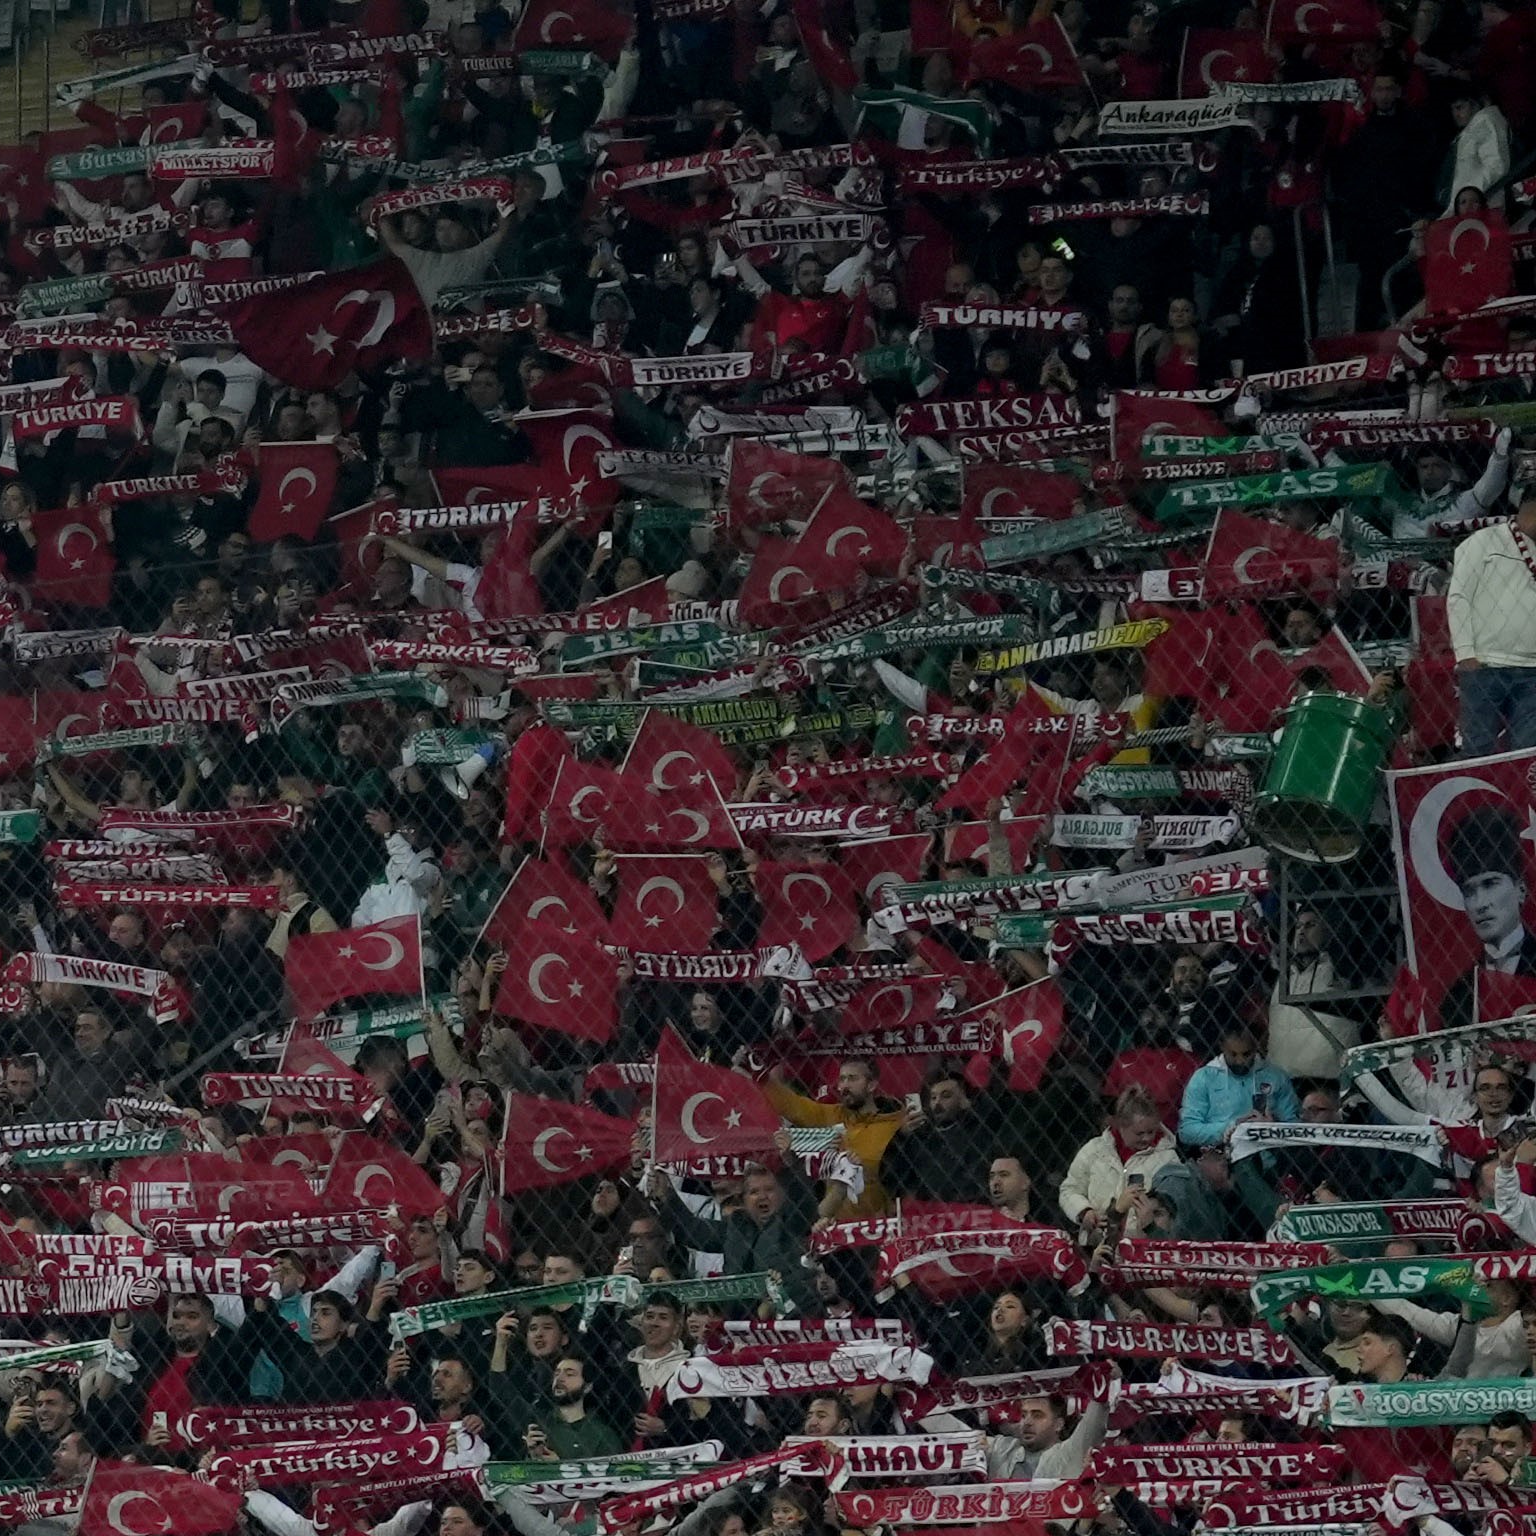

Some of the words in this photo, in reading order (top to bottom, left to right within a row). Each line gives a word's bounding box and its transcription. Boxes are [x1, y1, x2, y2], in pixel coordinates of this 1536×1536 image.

[742, 220, 863, 241] TÜRKİYE
[642, 361, 746, 380] TÜRKİYE
[16, 401, 122, 429] TÜRKİYE
[1333, 424, 1467, 445] TÜRKİYE
[110, 474, 199, 496] TÜRKİYE
[130, 701, 240, 721] TÜRKİYE
[56, 958, 146, 988] TÜRKİYE
[237, 1077, 354, 1100] TÜRKİYE
[224, 1411, 374, 1438] Türkiye
[249, 1450, 400, 1476] Türkiye
[1124, 1455, 1300, 1478] TÜRKİYE
[885, 1491, 1052, 1518] TÜRKİYE
